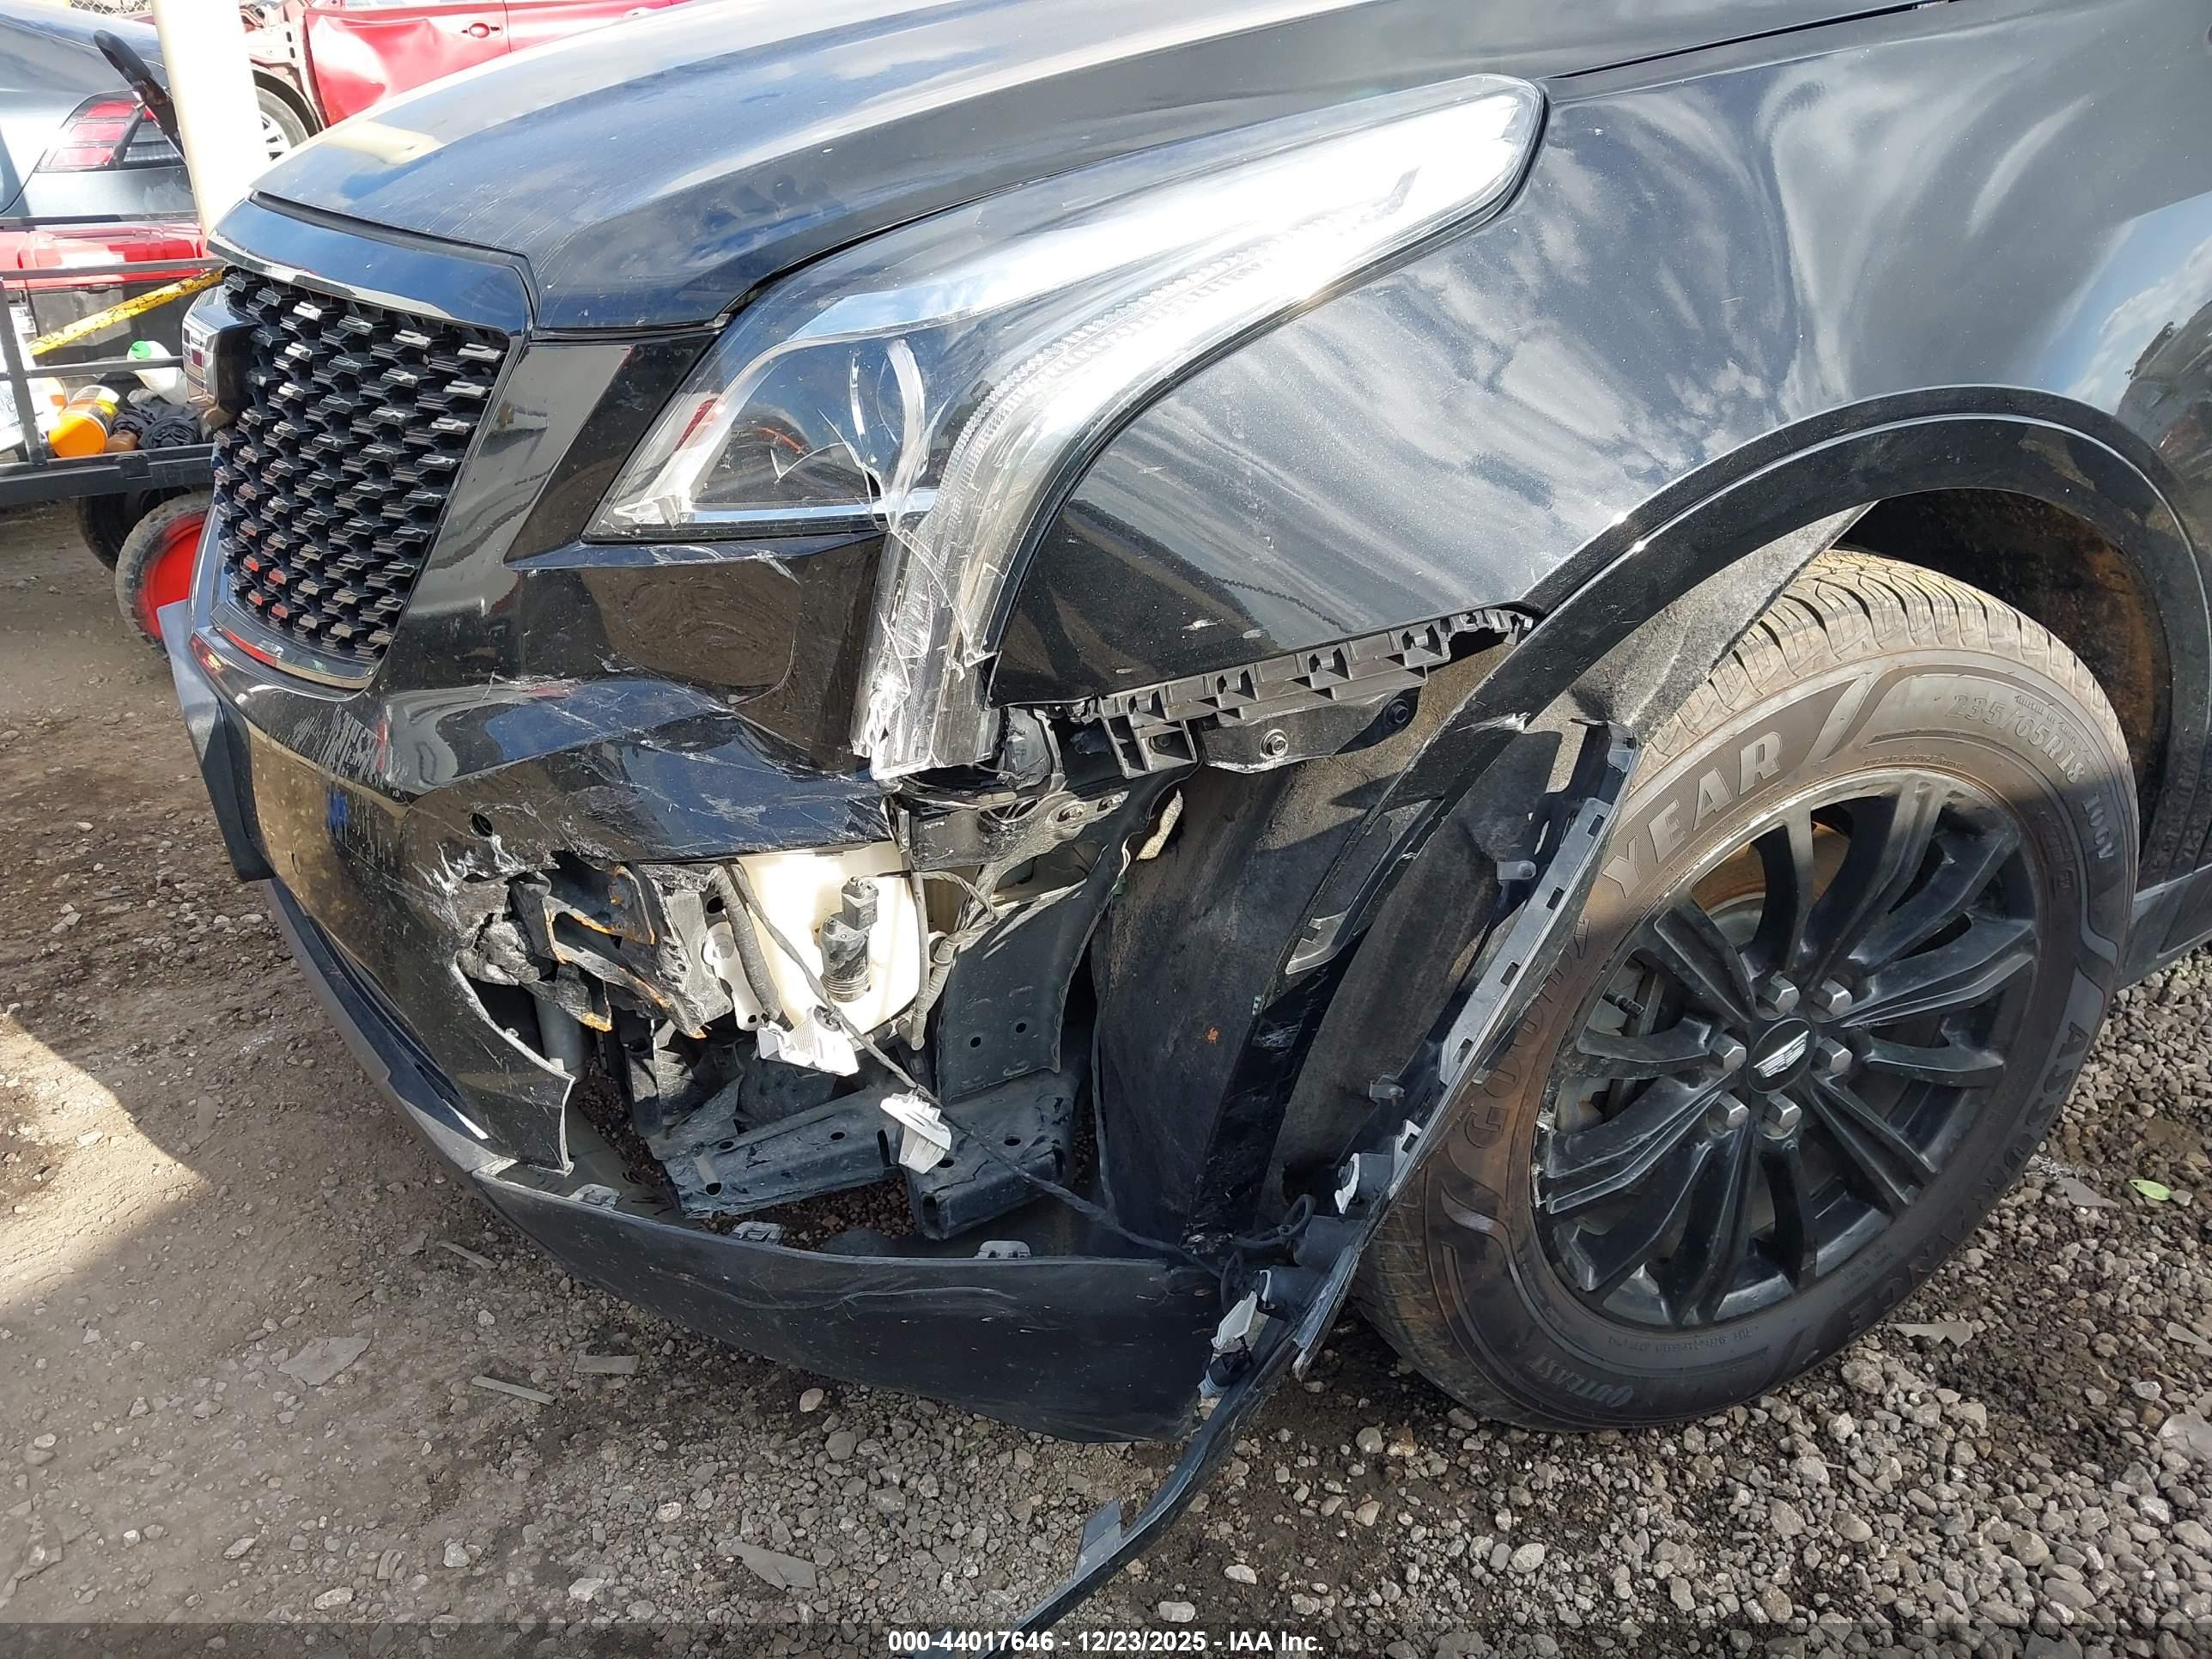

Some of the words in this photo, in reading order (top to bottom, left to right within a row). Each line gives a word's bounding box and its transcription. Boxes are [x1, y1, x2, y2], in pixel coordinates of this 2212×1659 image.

[1602, 731, 1784, 899] YEAR
[1944, 694, 2086, 784] 235/65R18
[2081, 791, 2115, 860] 106V
